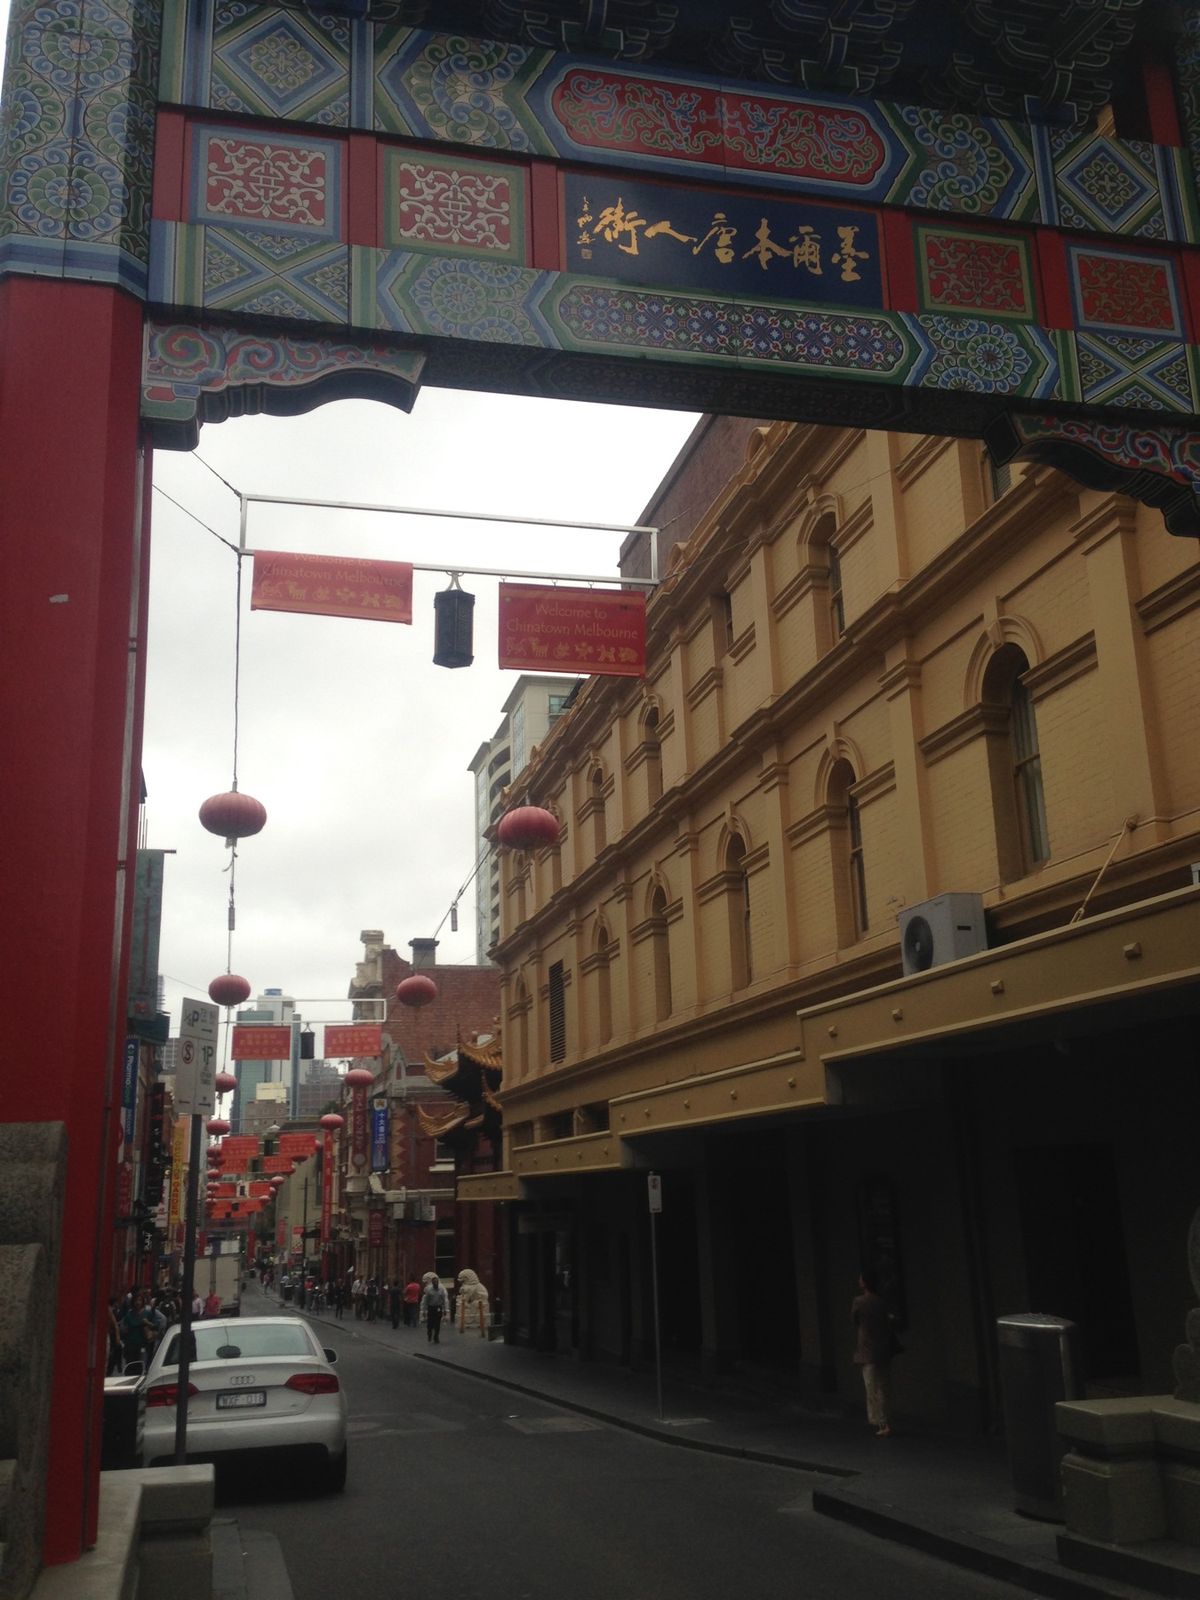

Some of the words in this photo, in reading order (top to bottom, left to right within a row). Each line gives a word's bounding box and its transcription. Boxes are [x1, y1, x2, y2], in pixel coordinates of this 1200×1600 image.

[295, 553, 352, 568] Welcome
[360, 559, 372, 567] to
[263, 563, 333, 580] Chinatown
[535, 602, 590, 618] Welcome
[595, 608, 607, 620] to
[506, 617, 570, 635] Chinatown
[574, 622, 638, 640] Melbourne
